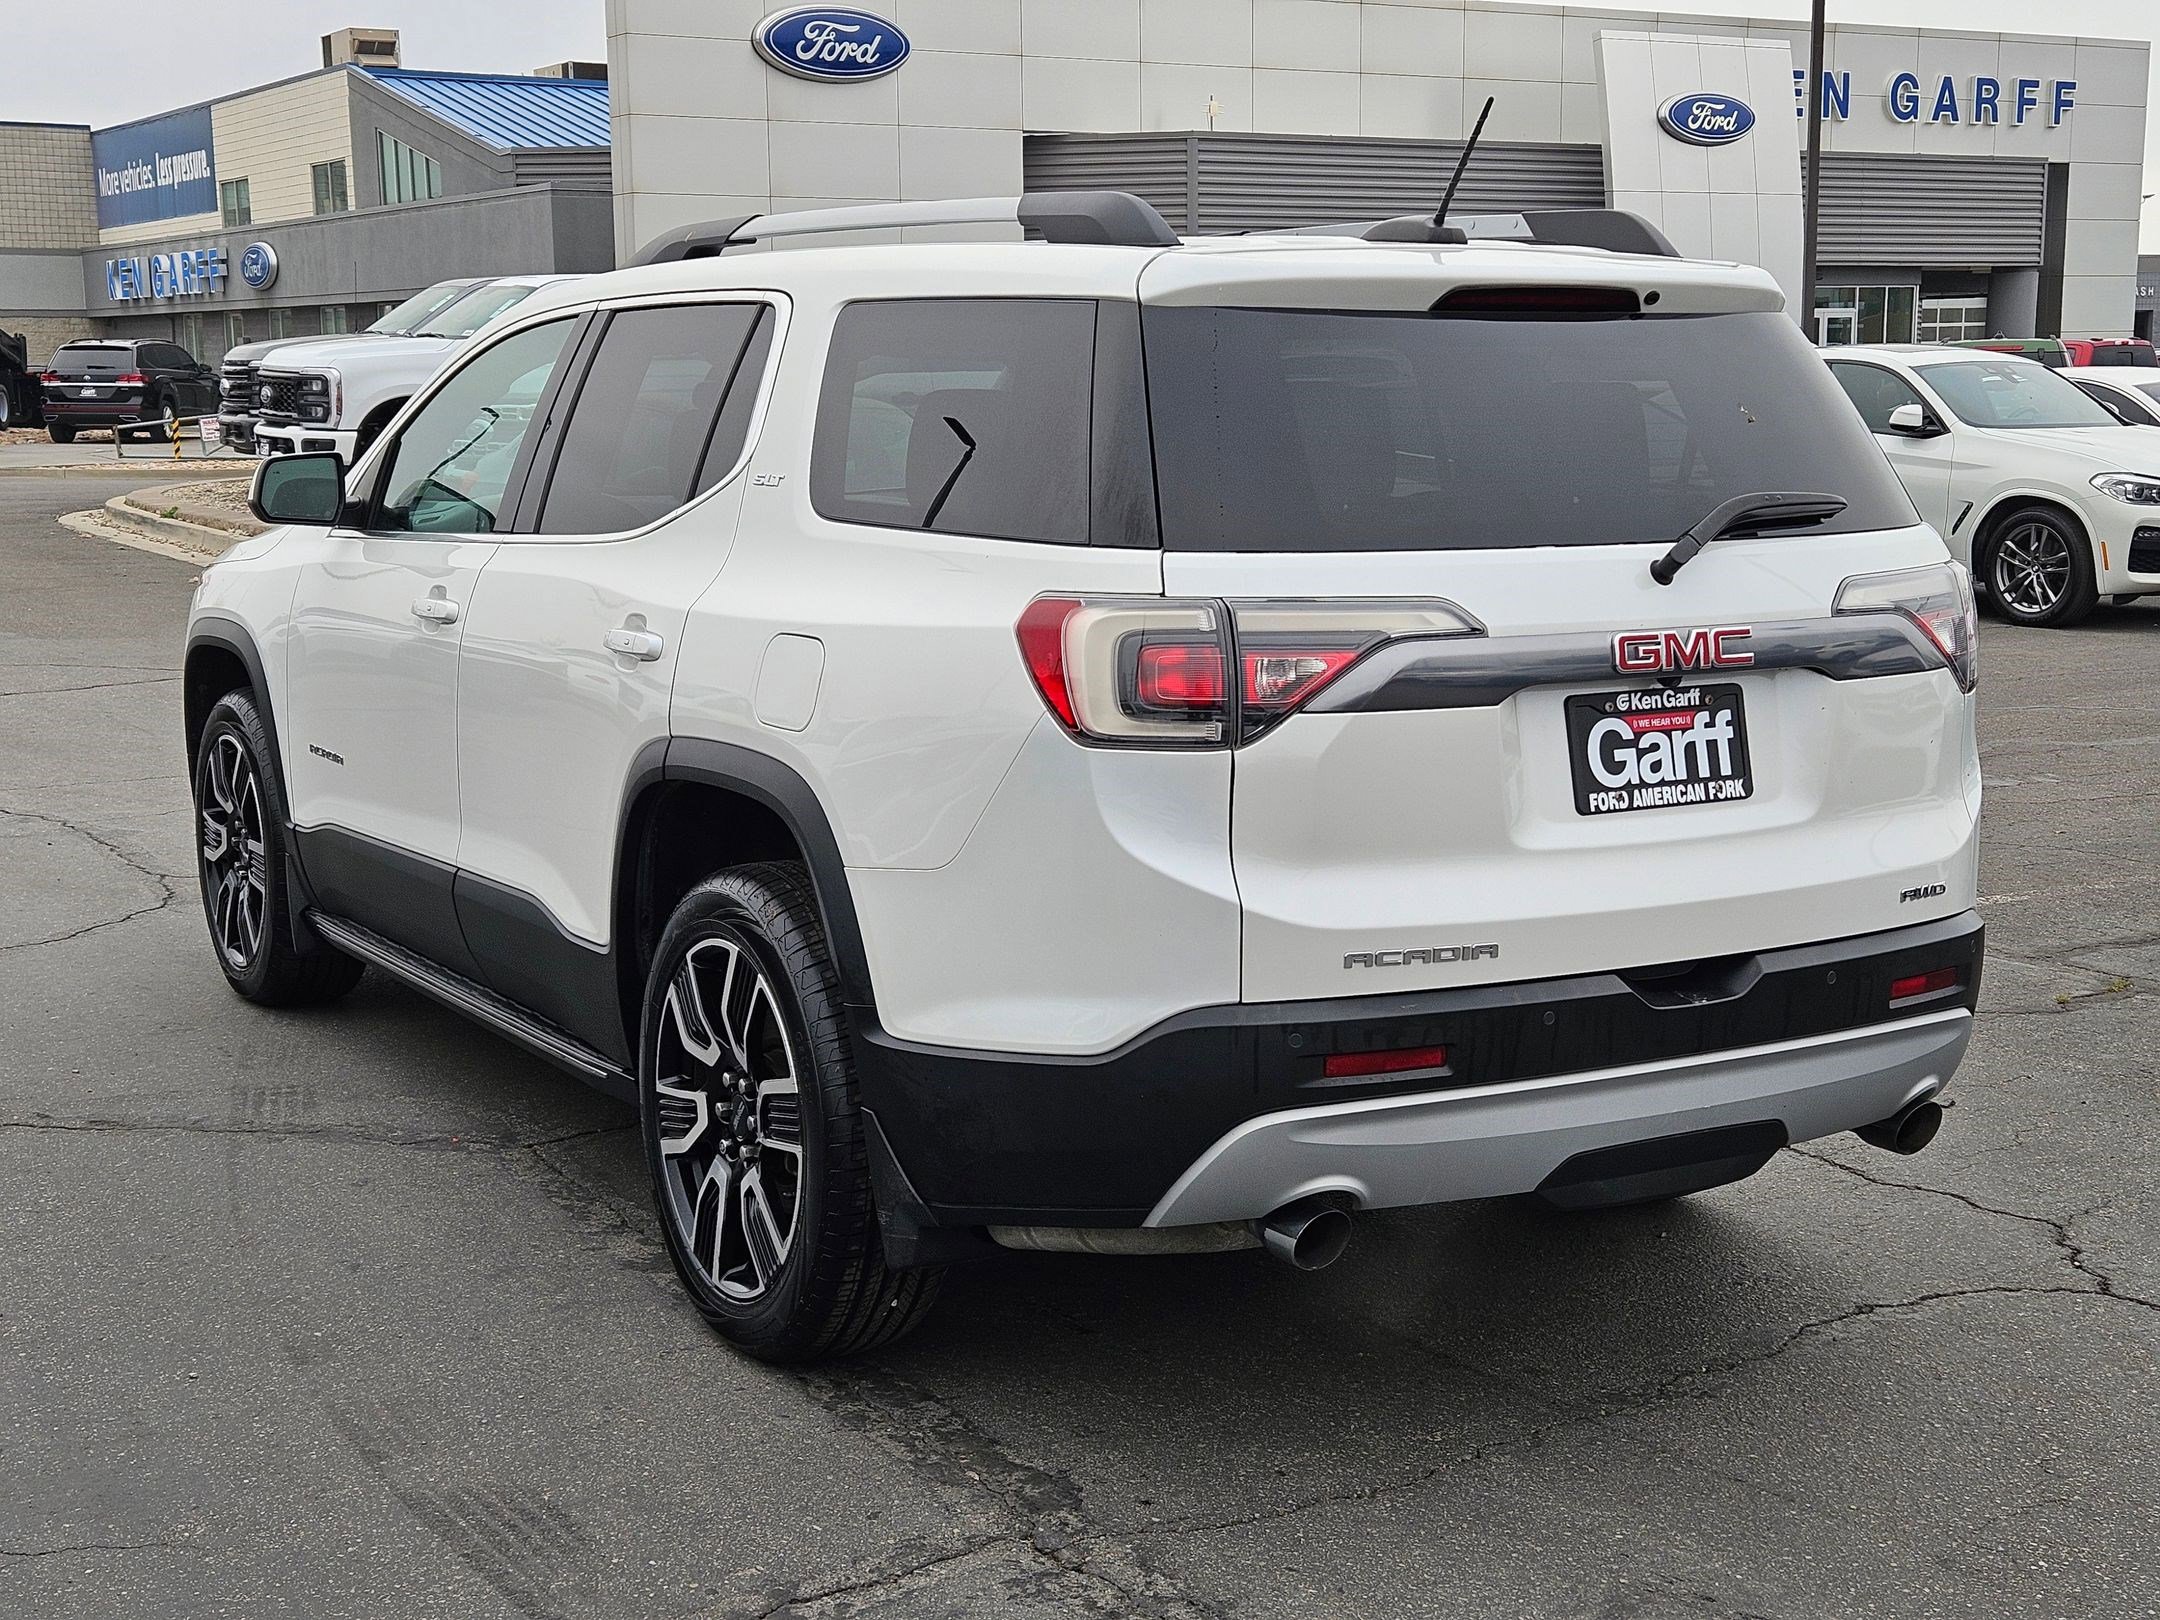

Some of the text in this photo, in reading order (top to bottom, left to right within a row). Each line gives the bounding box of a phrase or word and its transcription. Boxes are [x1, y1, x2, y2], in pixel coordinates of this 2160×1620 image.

[796, 20, 882, 64] Ford
[1887, 71, 2078, 127] GARFF
[1688, 101, 1738, 131] Ford
[98, 149, 210, 197] More vehicles. Less pressure.
[106, 247, 227, 301] KEN GARFF
[243, 253, 263, 278] Ford
[752, 473, 785, 488] SLT
[1612, 626, 1754, 673] GMC
[1631, 688, 1700, 710] Ken Garff
[1639, 716, 1686, 728] WE HEAR YOU
[1587, 708, 1734, 788] Garff
[1589, 778, 1746, 812] FORD AMERICAN FORK
[1900, 881, 1946, 903] AWD
[1343, 942, 1499, 969] ACADIA
